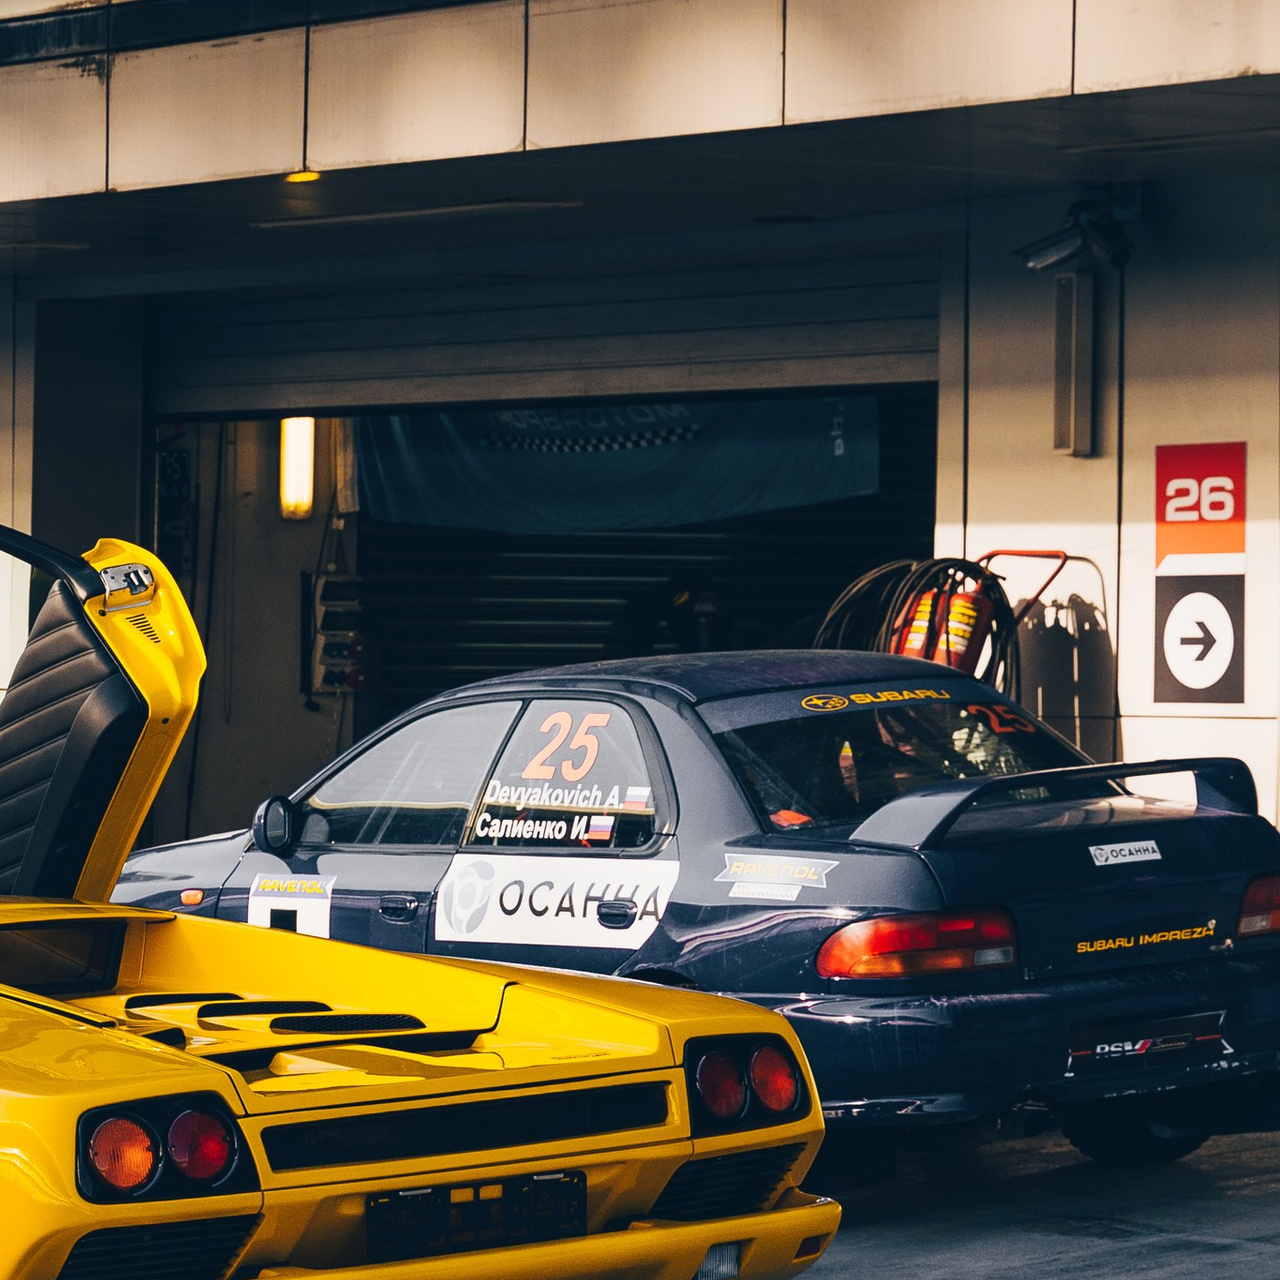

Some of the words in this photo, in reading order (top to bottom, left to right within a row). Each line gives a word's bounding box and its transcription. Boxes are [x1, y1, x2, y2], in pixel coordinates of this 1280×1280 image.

[1165, 476, 1234, 522] 26
[849, 689, 951, 704] SUBARU
[967, 704, 1036, 734] 25
[521, 711, 611, 782] 25
[484, 779, 603, 810] Devyakovich
[604, 785, 624, 809] A.
[476, 812, 567, 840] Салиенко
[570, 815, 589, 840] И.
[1110, 845, 1158, 858] ОСАННА
[259, 879, 324, 894] RAVENOL
[1077, 936, 1134, 953] SUBARU
[1139, 926, 1214, 945] IMPREZA
